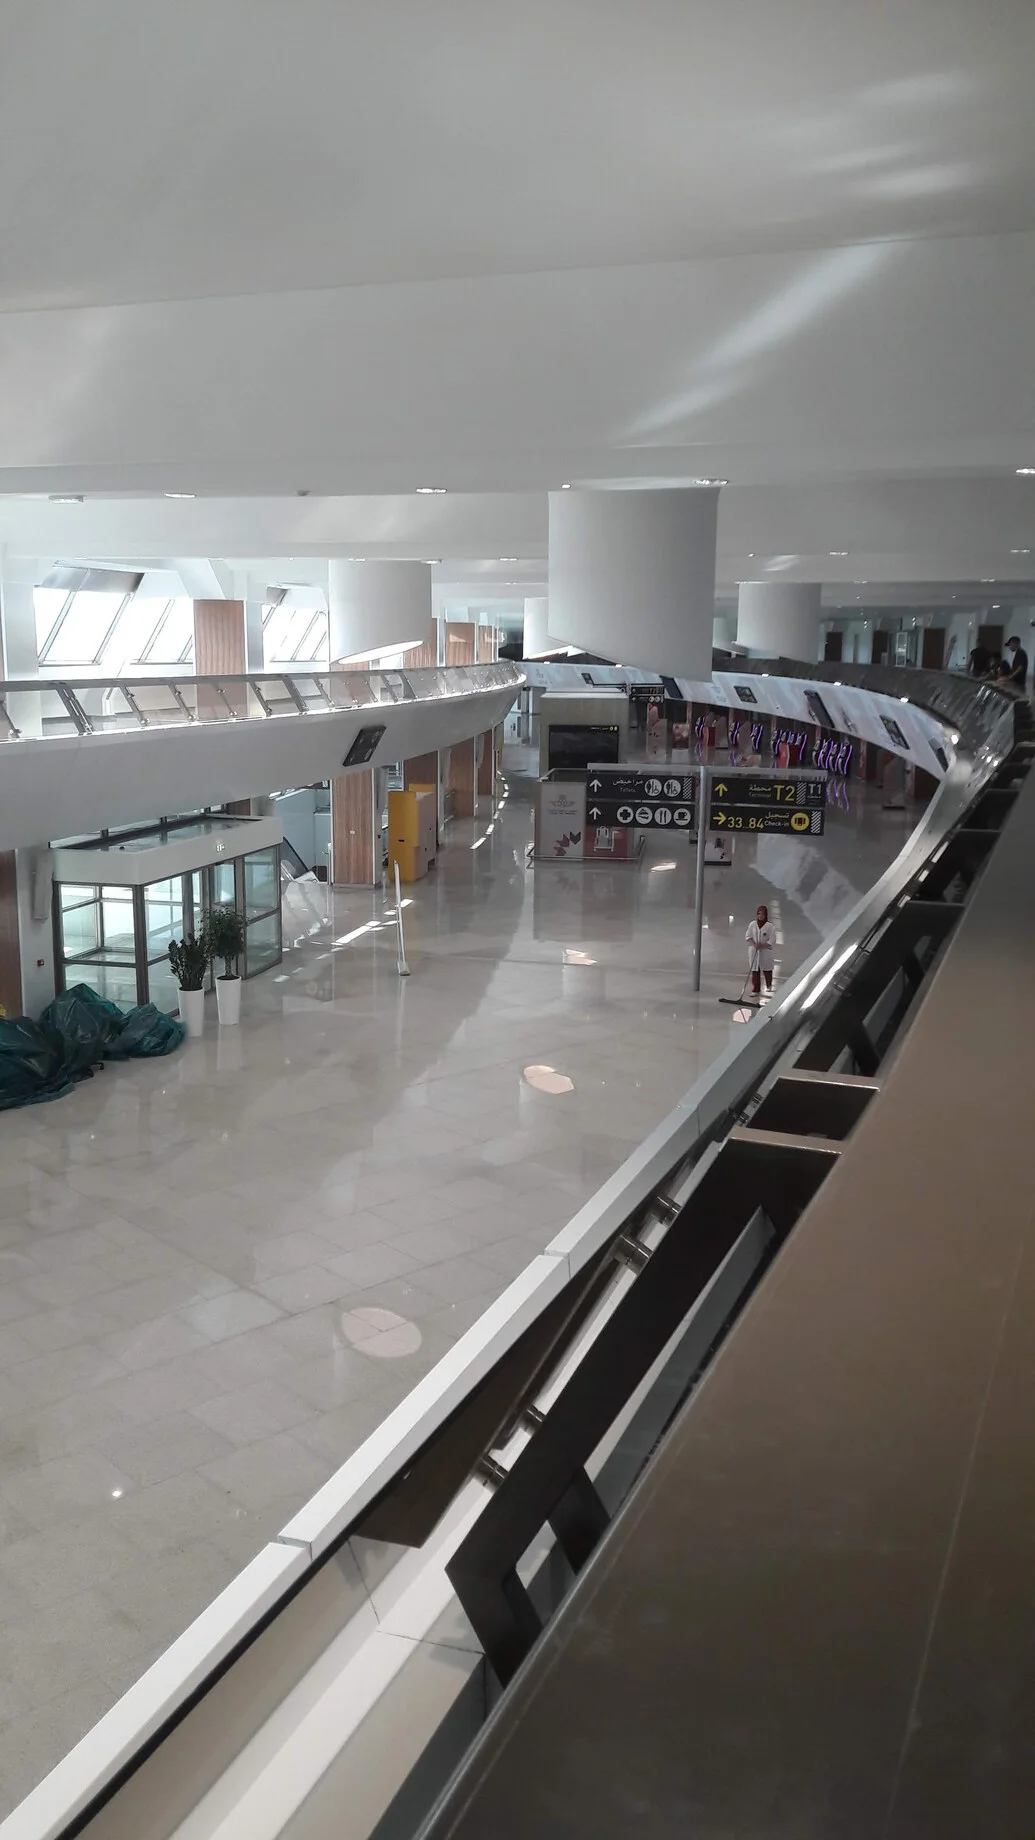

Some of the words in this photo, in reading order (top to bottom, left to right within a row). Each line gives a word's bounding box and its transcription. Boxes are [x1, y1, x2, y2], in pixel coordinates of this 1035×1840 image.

[612, 777, 643, 786] مراحيض
[749, 784, 772, 792] محطة
[808, 784, 822, 795] T1
[773, 785, 796, 801] T2
[765, 811, 790, 820] تسجيل
[764, 820, 789, 828] Check-in
